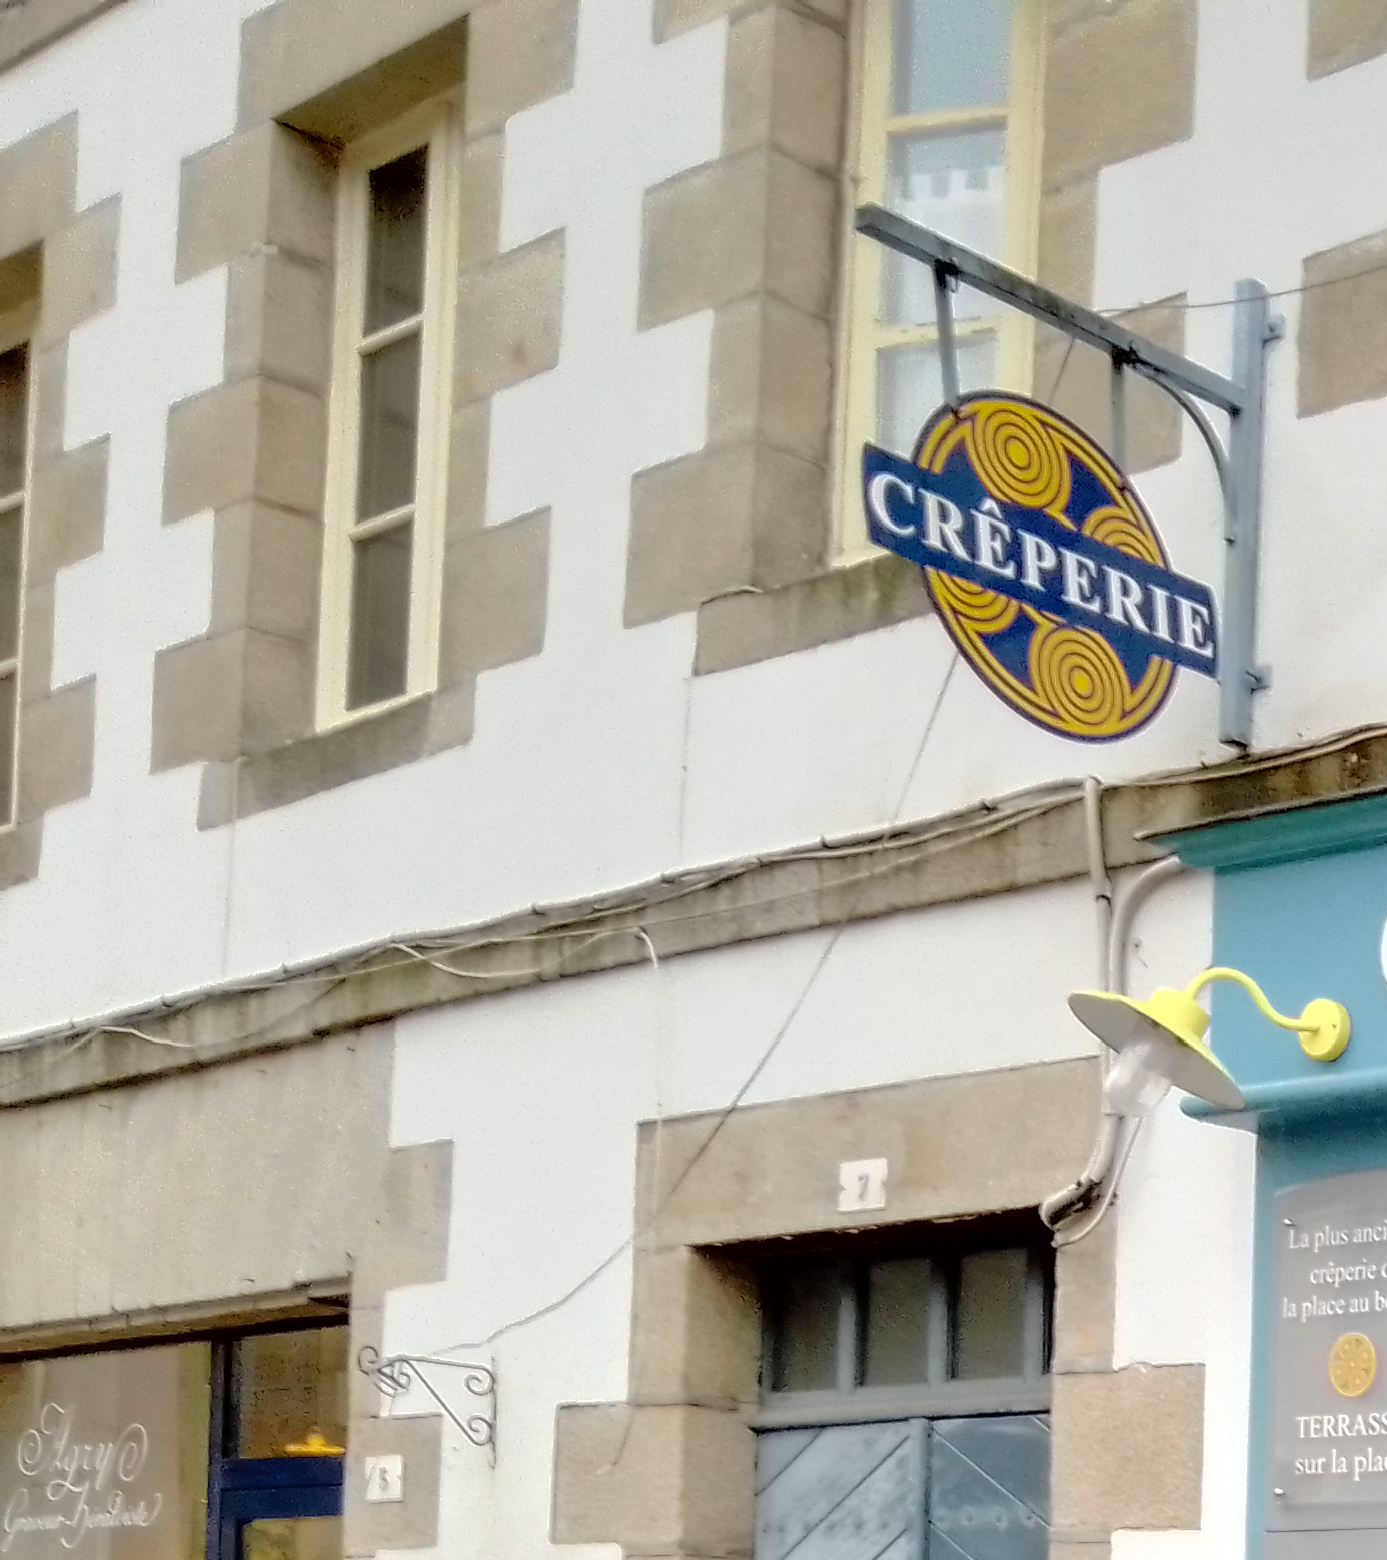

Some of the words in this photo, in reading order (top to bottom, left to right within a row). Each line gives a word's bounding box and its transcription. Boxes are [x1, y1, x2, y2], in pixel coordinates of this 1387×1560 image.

[868, 473, 1215, 659] CRÊPERIE
[1288, 1228, 1310, 1249] La
[1314, 1225, 1349, 1252] plus
[1310, 1258, 1377, 1288] crêperie
[1283, 1297, 1297, 1318] la
[1302, 1295, 1345, 1323] place
[1350, 1298, 1370, 1314] au
[1295, 1456, 1326, 1475] sur
[1331, 1448, 1348, 1474] la
